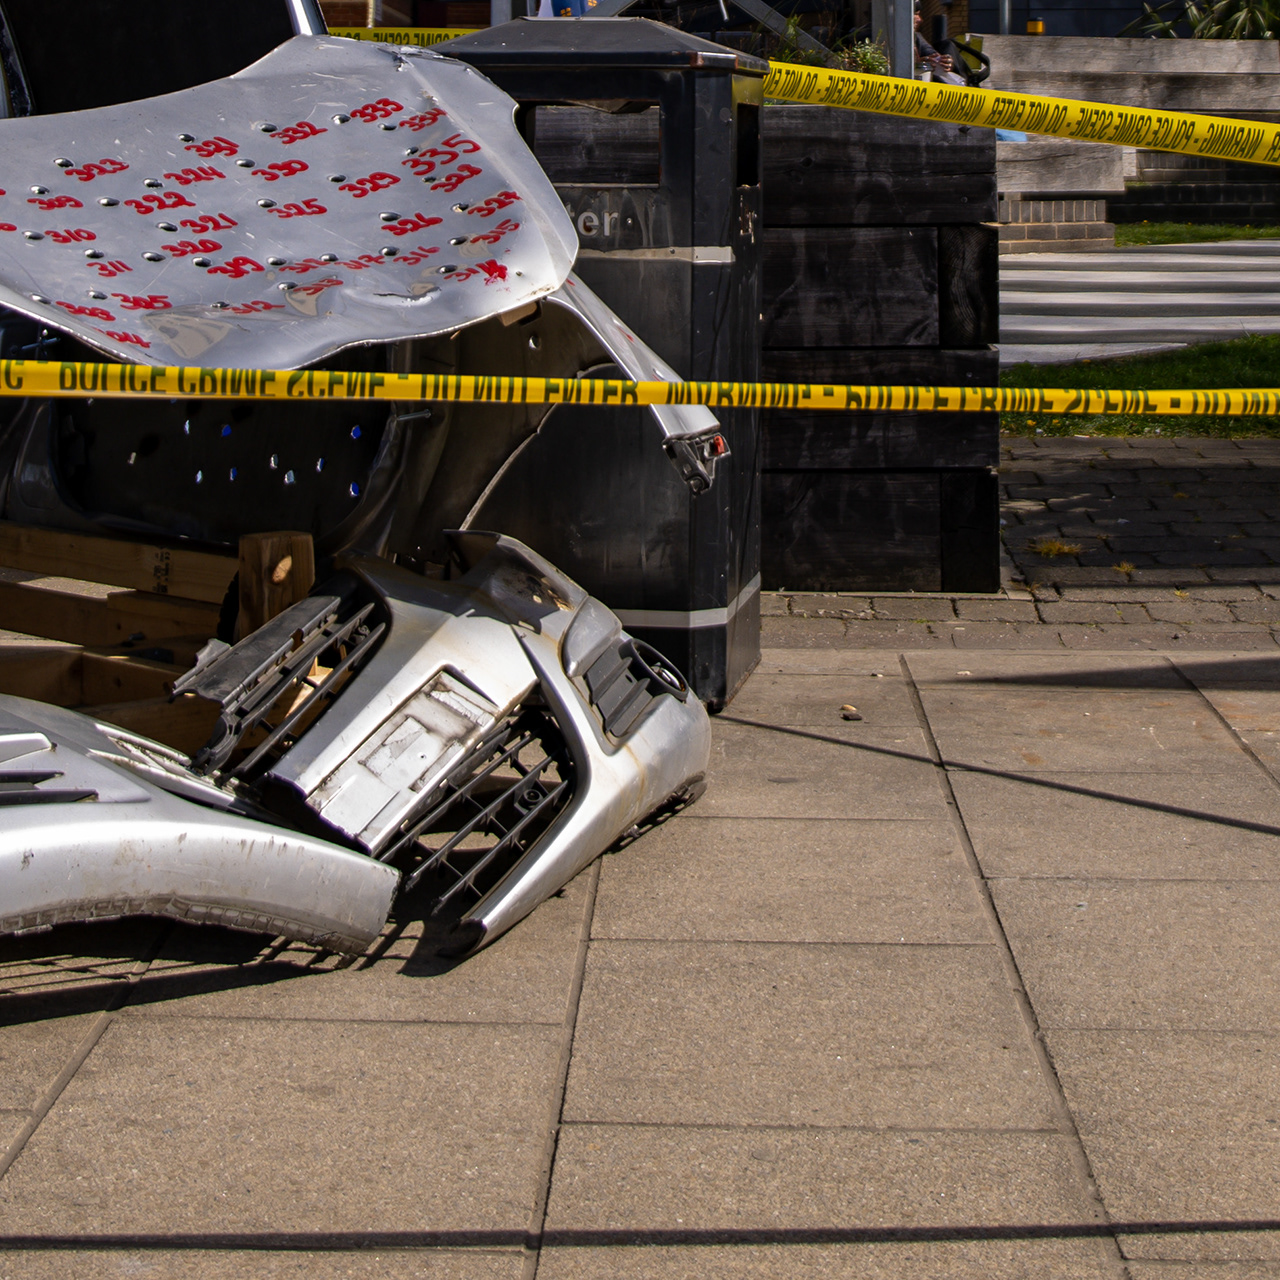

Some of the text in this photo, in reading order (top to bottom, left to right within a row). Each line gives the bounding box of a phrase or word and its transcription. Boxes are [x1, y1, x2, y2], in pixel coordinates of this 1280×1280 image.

[350, 98, 404, 124] 333
[270, 121, 328, 146] 332
[401, 133, 481, 176] 335
[163, 166, 226, 187] 324
[251, 159, 309, 182] 330
[124, 191, 196, 215] 322
[267, 198, 328, 219] 325
[179, 213, 238, 235] 321
[381, 212, 443, 237] 326
[470, 219, 520, 244] 315
[44, 228, 97, 244] 310
[160, 239, 223, 258] 320
[392, 246, 440, 266] 316
[86, 260, 134, 277] 311
[110, 293, 172, 310] 305
